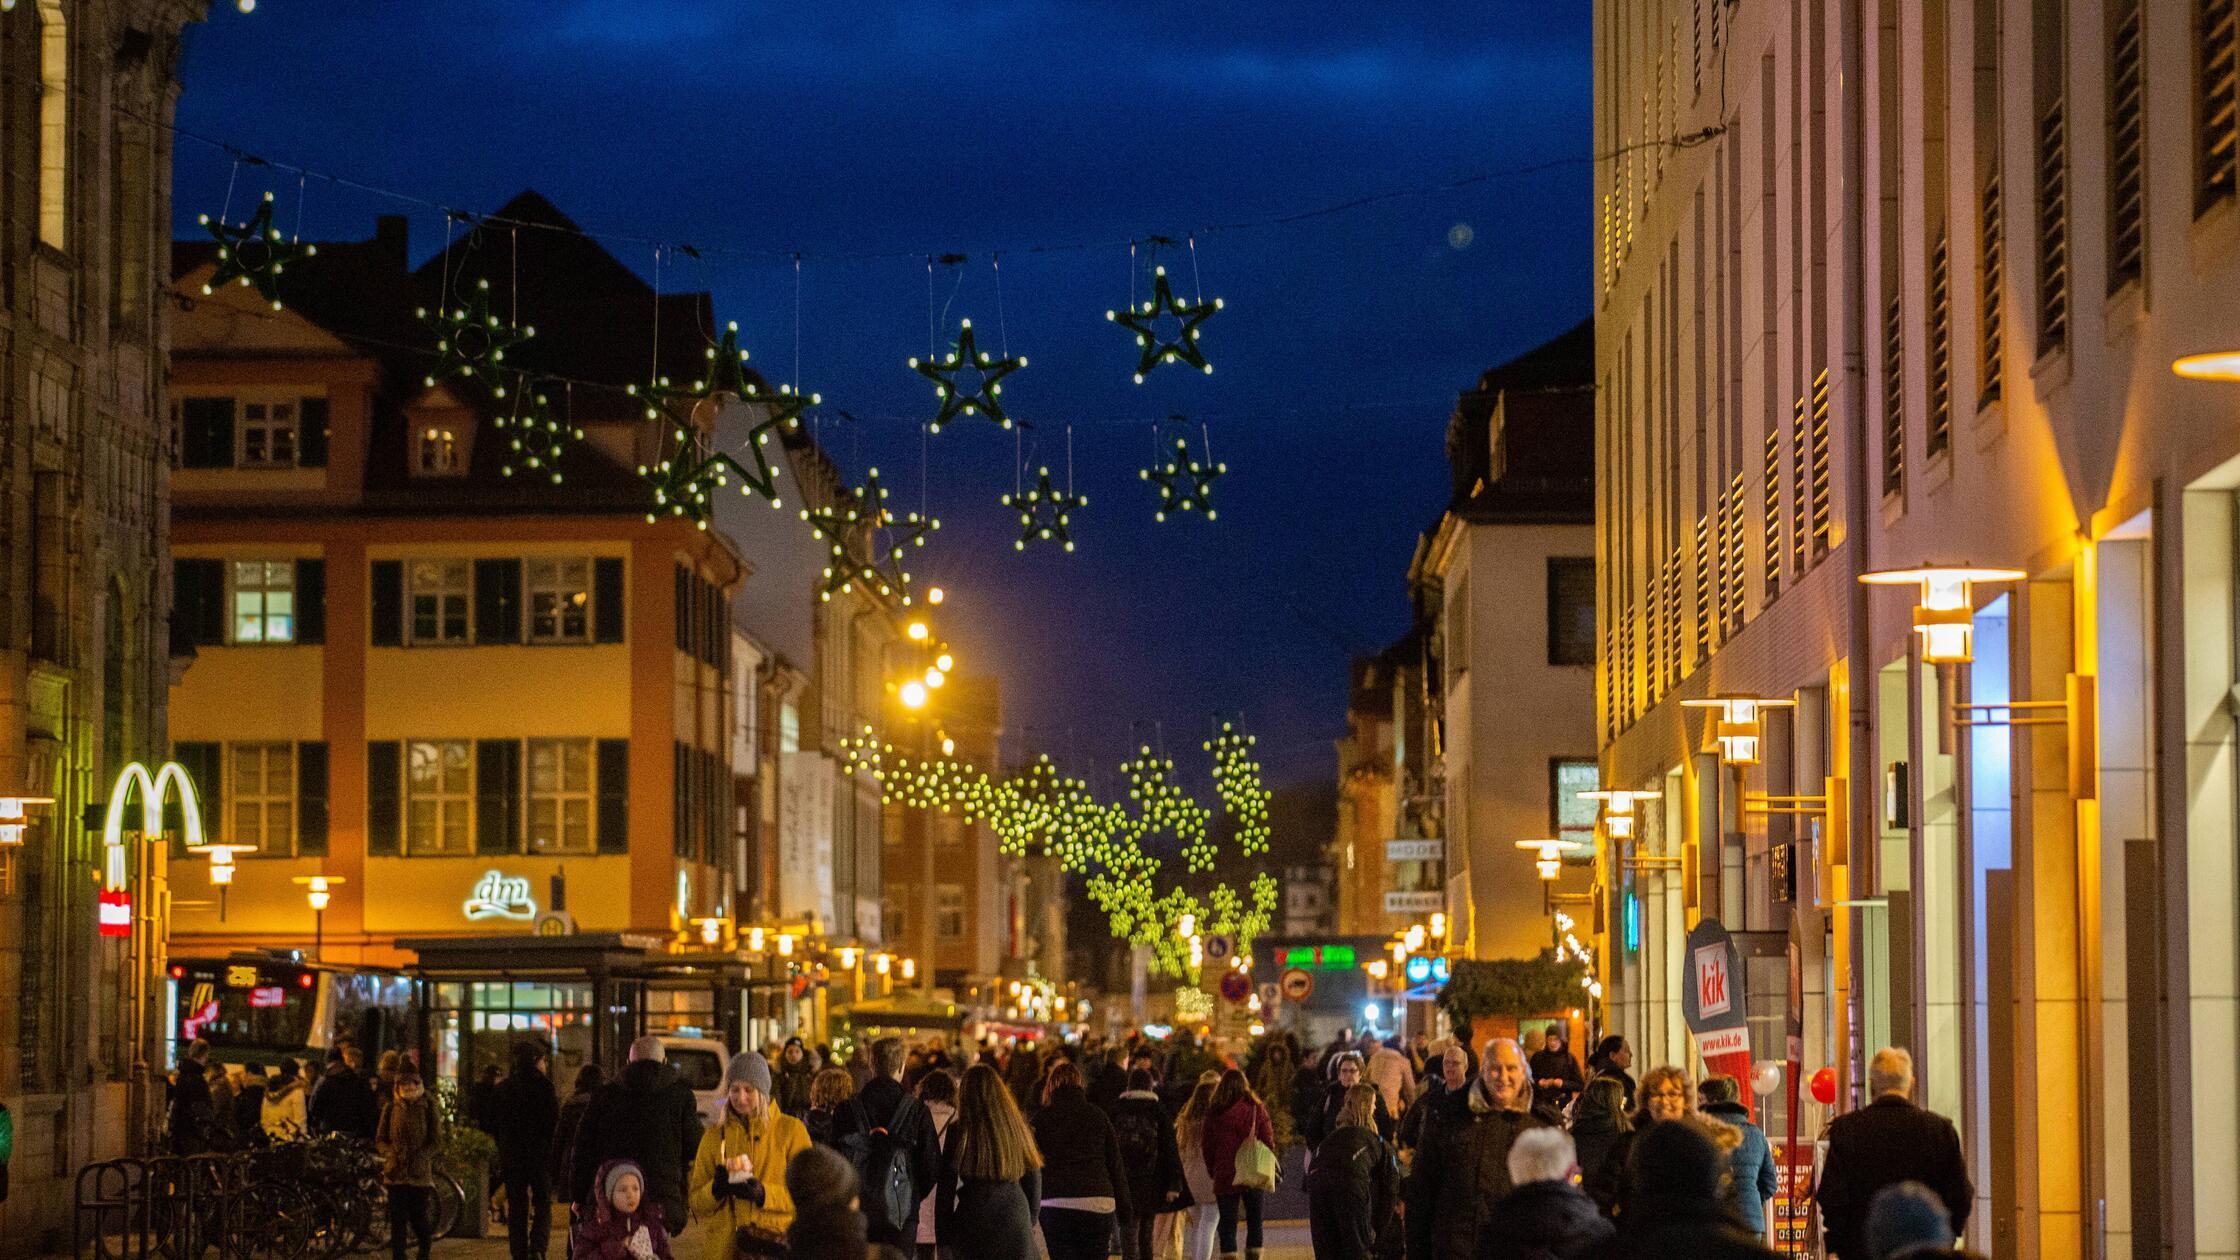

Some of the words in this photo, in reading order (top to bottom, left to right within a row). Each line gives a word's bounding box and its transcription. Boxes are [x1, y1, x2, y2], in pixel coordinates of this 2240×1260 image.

[473, 869, 528, 908] dm
[1702, 955, 1725, 1008] kik
[1702, 1034, 1742, 1052] www.kik.de
